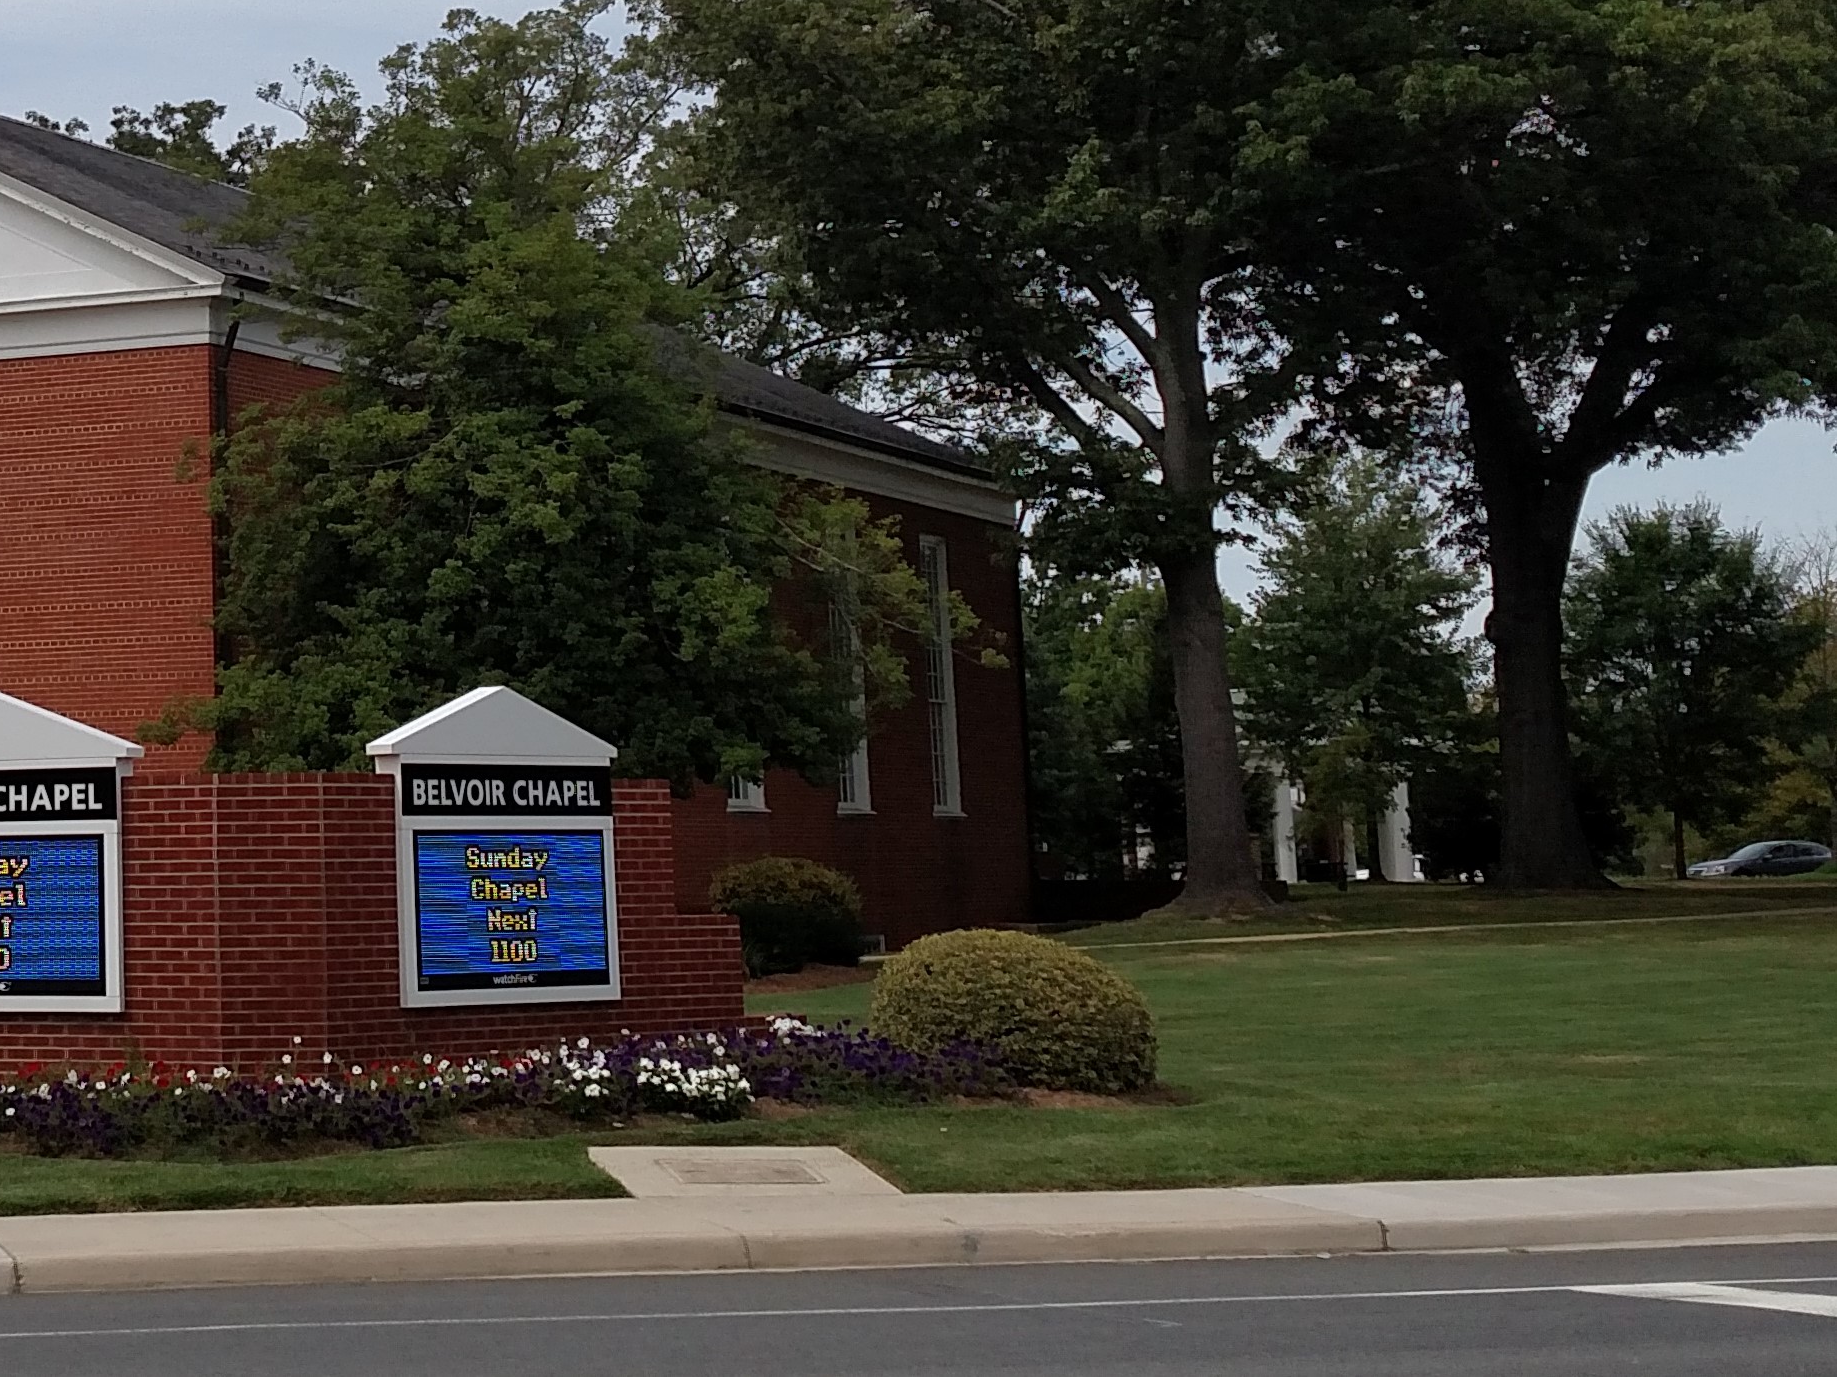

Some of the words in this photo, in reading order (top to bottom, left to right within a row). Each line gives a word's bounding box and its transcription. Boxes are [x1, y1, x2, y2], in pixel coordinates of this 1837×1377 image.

[413, 780, 505, 806] BELVOIR
[513, 780, 600, 807] CHAPEL
[466, 847, 548, 870] Sunday
[472, 878, 548, 901] Chapel
[488, 910, 536, 931] Next
[492, 941, 537, 961] 1100
